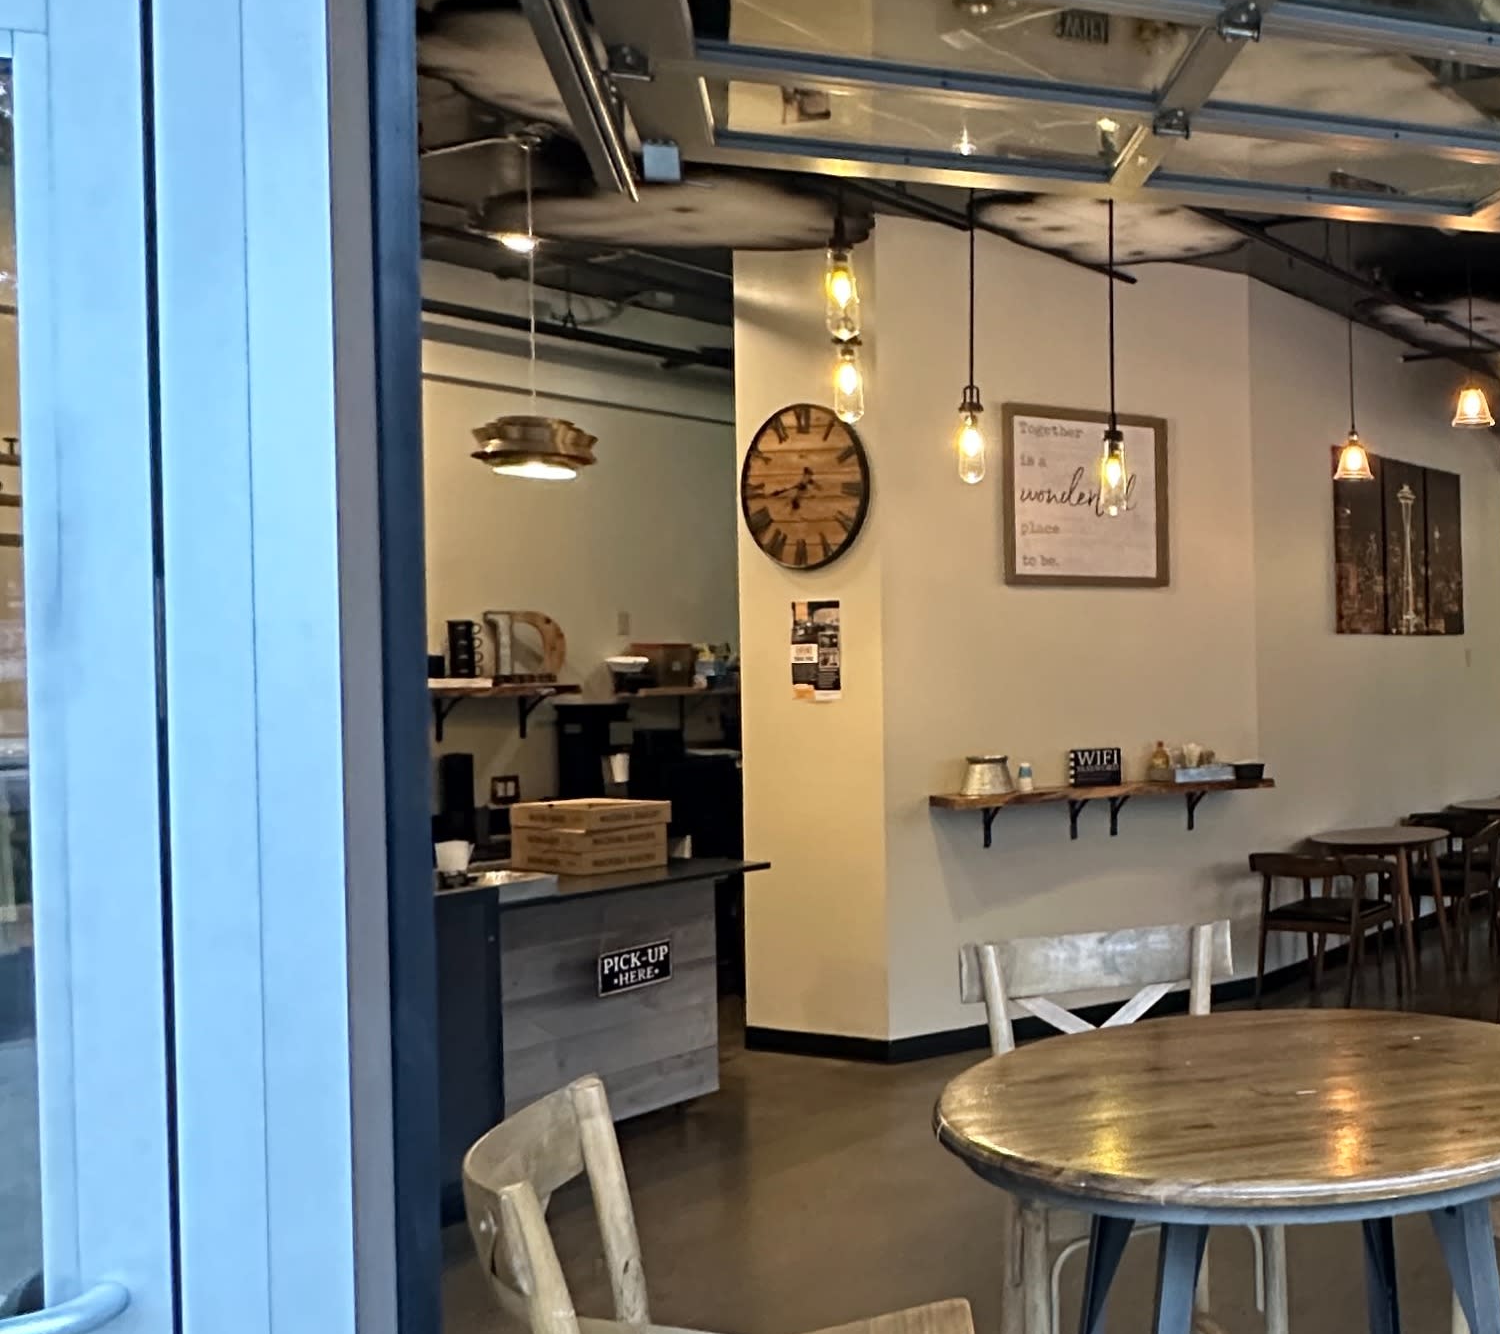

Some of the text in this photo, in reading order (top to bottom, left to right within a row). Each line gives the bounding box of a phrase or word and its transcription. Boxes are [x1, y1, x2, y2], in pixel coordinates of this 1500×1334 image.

[1019, 421, 1083, 439] Together
[1020, 467, 1137, 517] wonderl
[1021, 522, 1060, 536] place
[1022, 555, 1037, 566] to
[1077, 750, 1118, 765] WIFI
[604, 945, 668, 975] PICK-UP
